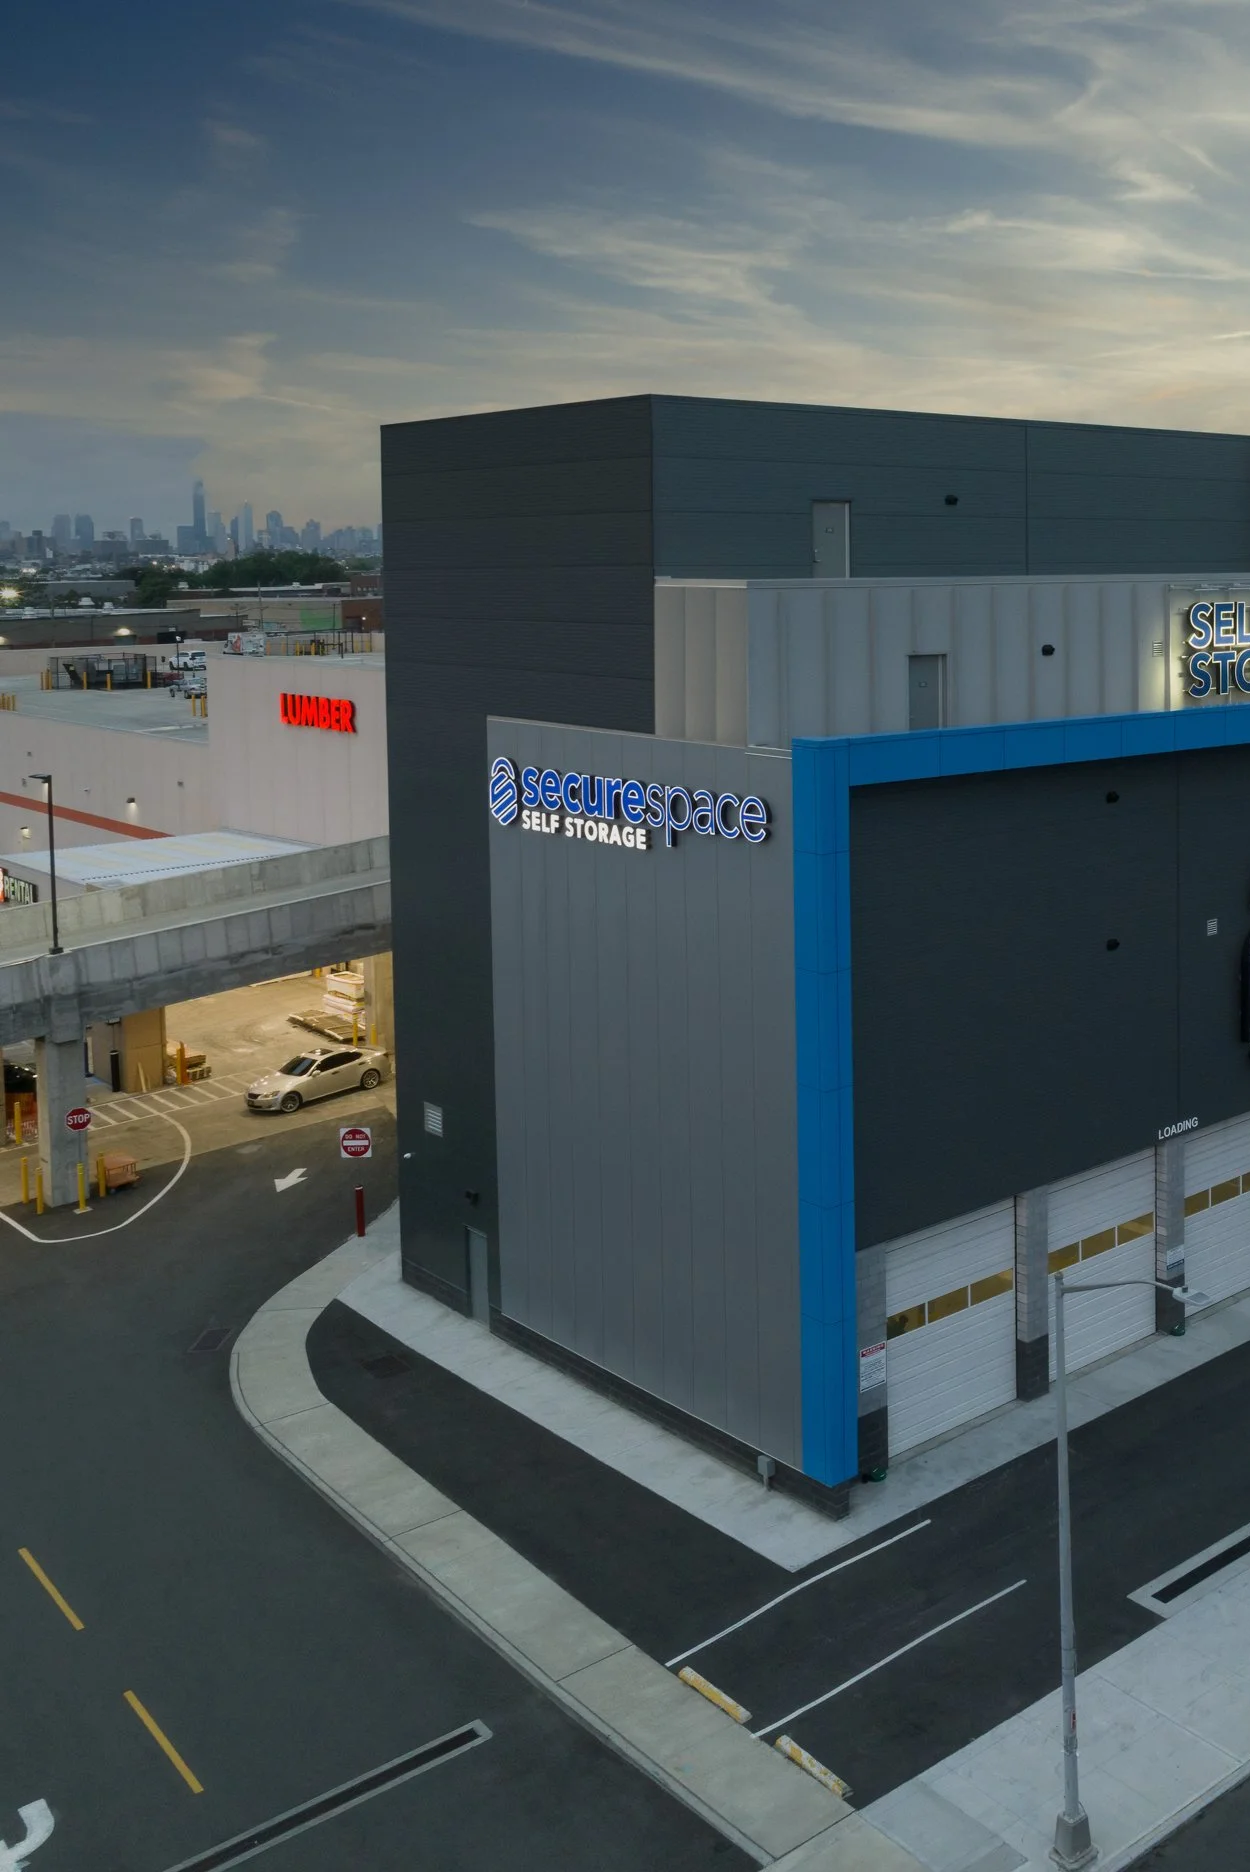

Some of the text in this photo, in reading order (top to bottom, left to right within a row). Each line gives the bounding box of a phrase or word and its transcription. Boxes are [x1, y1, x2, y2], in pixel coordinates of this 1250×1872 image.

[280, 692, 355, 733] LUMBER
[521, 766, 768, 847] securespace
[521, 809, 647, 850] SELF STORAGE
[4, 875, 34, 904] RENTAL
[67, 1113, 90, 1125] STOP
[1158, 1116, 1198, 1140] LOADING
